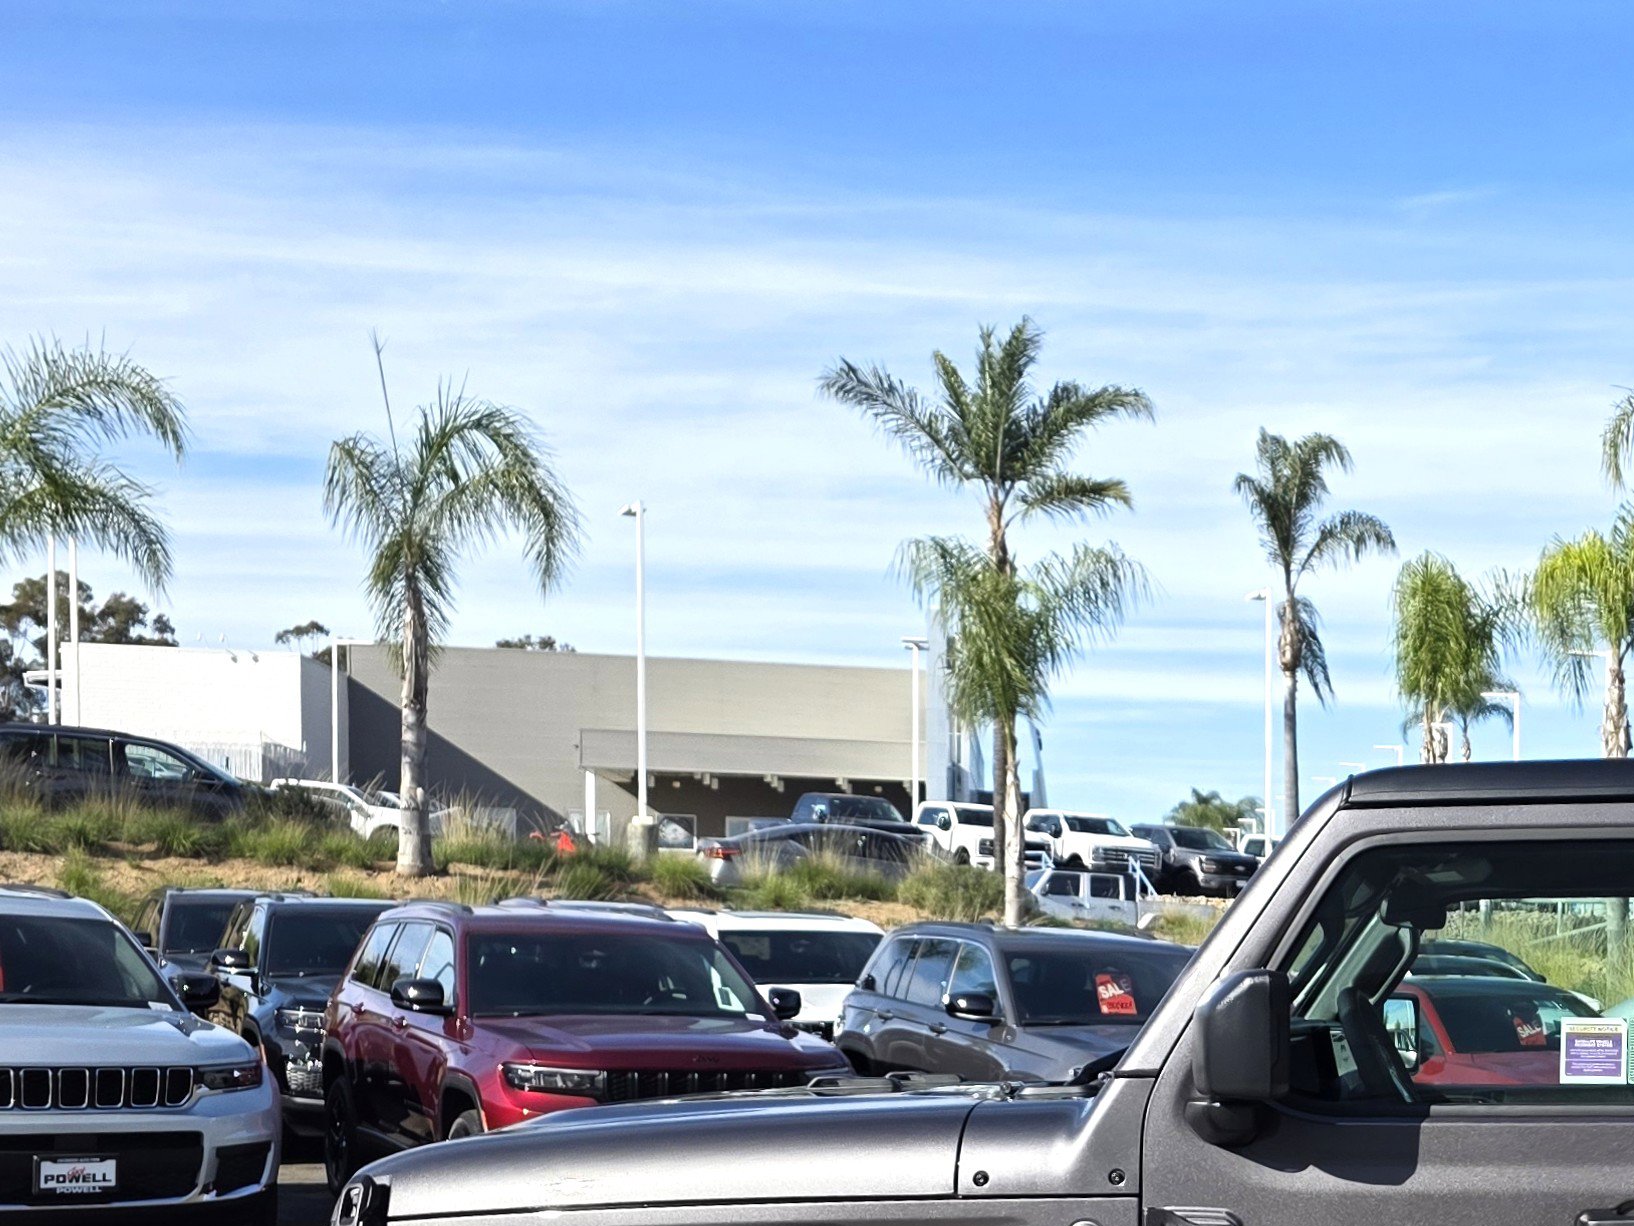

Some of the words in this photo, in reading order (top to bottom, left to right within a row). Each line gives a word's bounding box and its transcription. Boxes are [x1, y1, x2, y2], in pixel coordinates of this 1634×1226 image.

[1098, 979, 1131, 999] SALE
[1517, 1021, 1541, 1038] SALE
[44, 1172, 112, 1185] POWELL
[56, 1185, 102, 1194] POWELL
